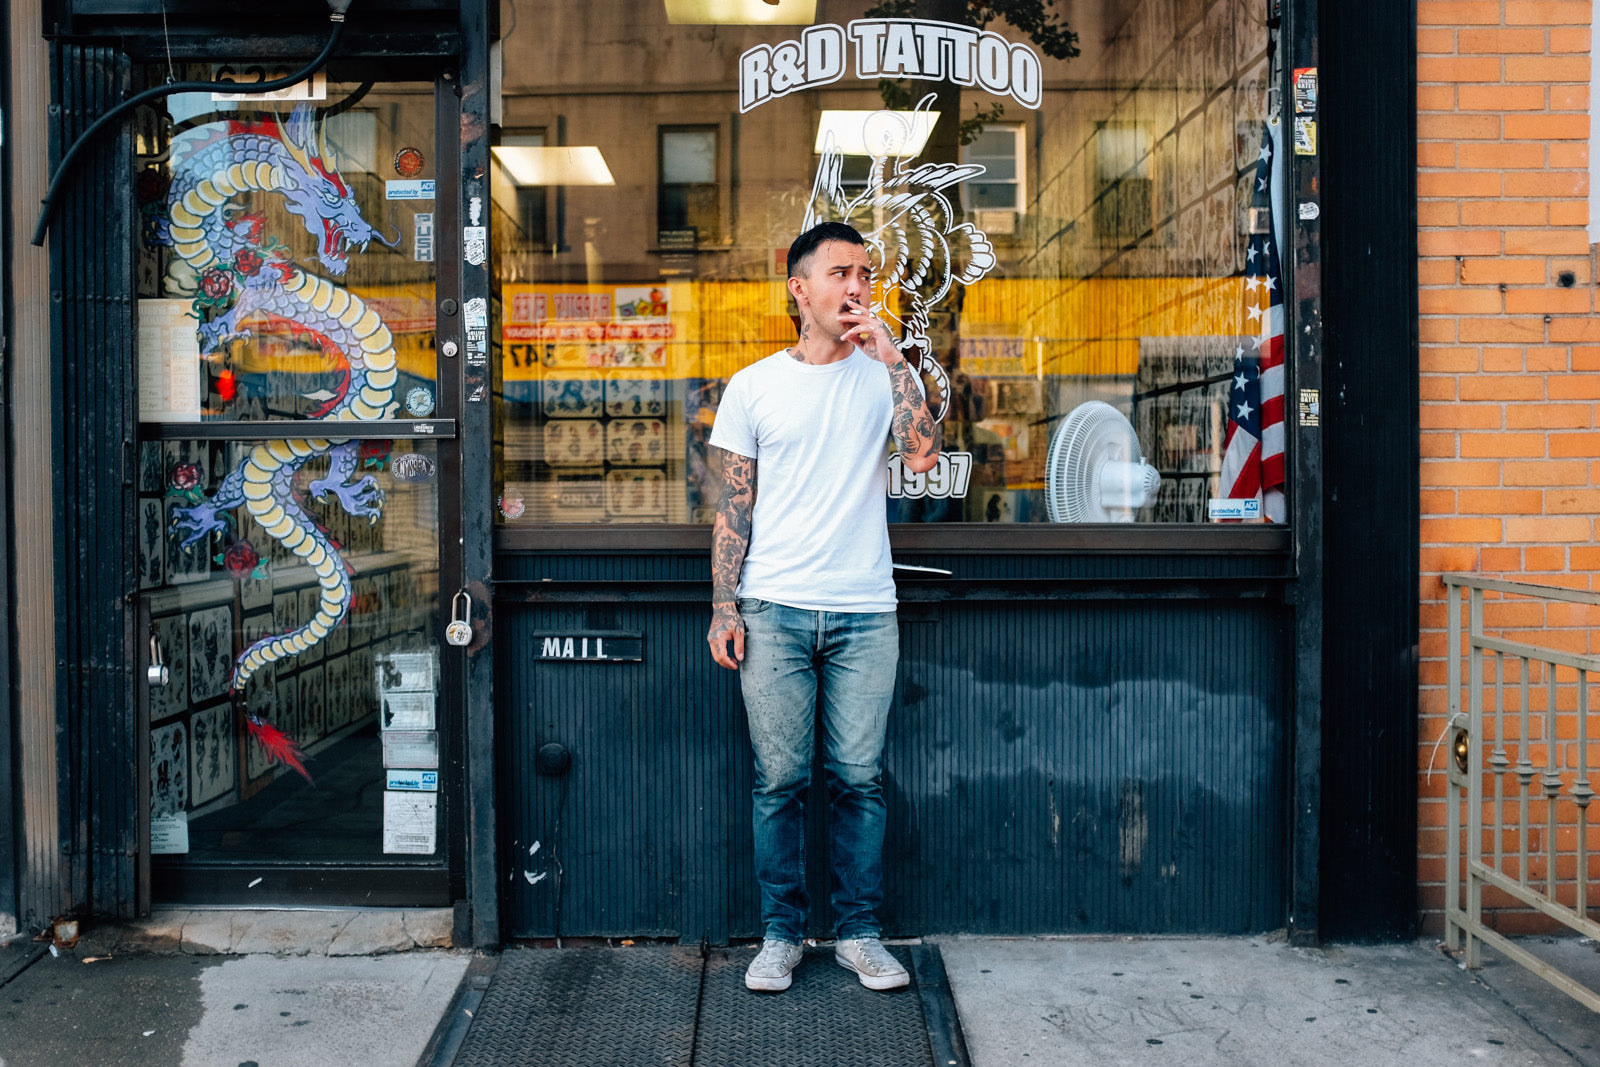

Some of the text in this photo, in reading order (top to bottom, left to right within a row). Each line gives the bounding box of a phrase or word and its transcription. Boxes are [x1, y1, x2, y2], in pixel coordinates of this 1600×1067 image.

[740, 18, 1042, 113] R&D TATTOO
[422, 182, 435, 191] ADT
[887, 452, 973, 499] 1997
[1244, 500, 1258, 511] ADT
[542, 637, 608, 659] MAIL
[422, 773, 436, 783] ADT
